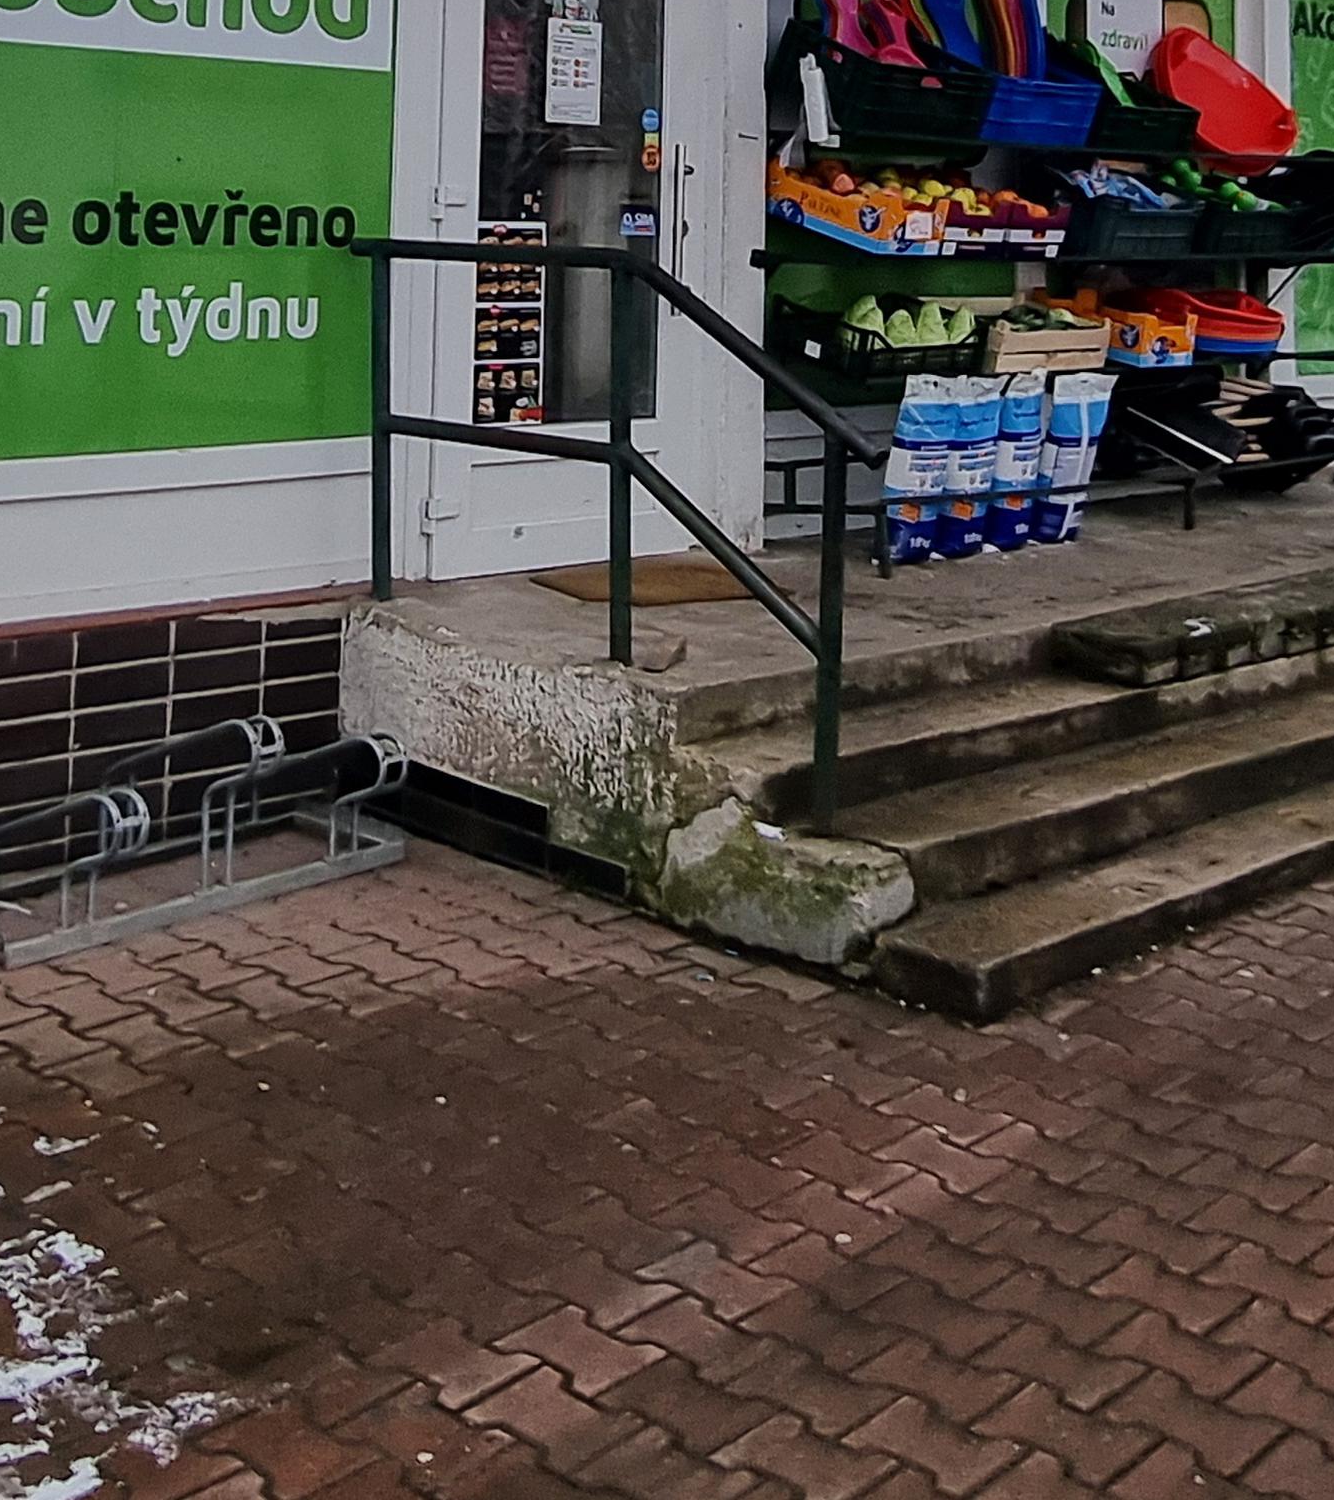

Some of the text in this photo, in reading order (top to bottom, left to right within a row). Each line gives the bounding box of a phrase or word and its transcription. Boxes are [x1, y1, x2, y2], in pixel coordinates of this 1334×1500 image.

[1100, 0, 1116, 17] Na
[71, 189, 356, 248] otevřeno
[73, 298, 116, 344] v
[136, 281, 321, 357] týdnu
